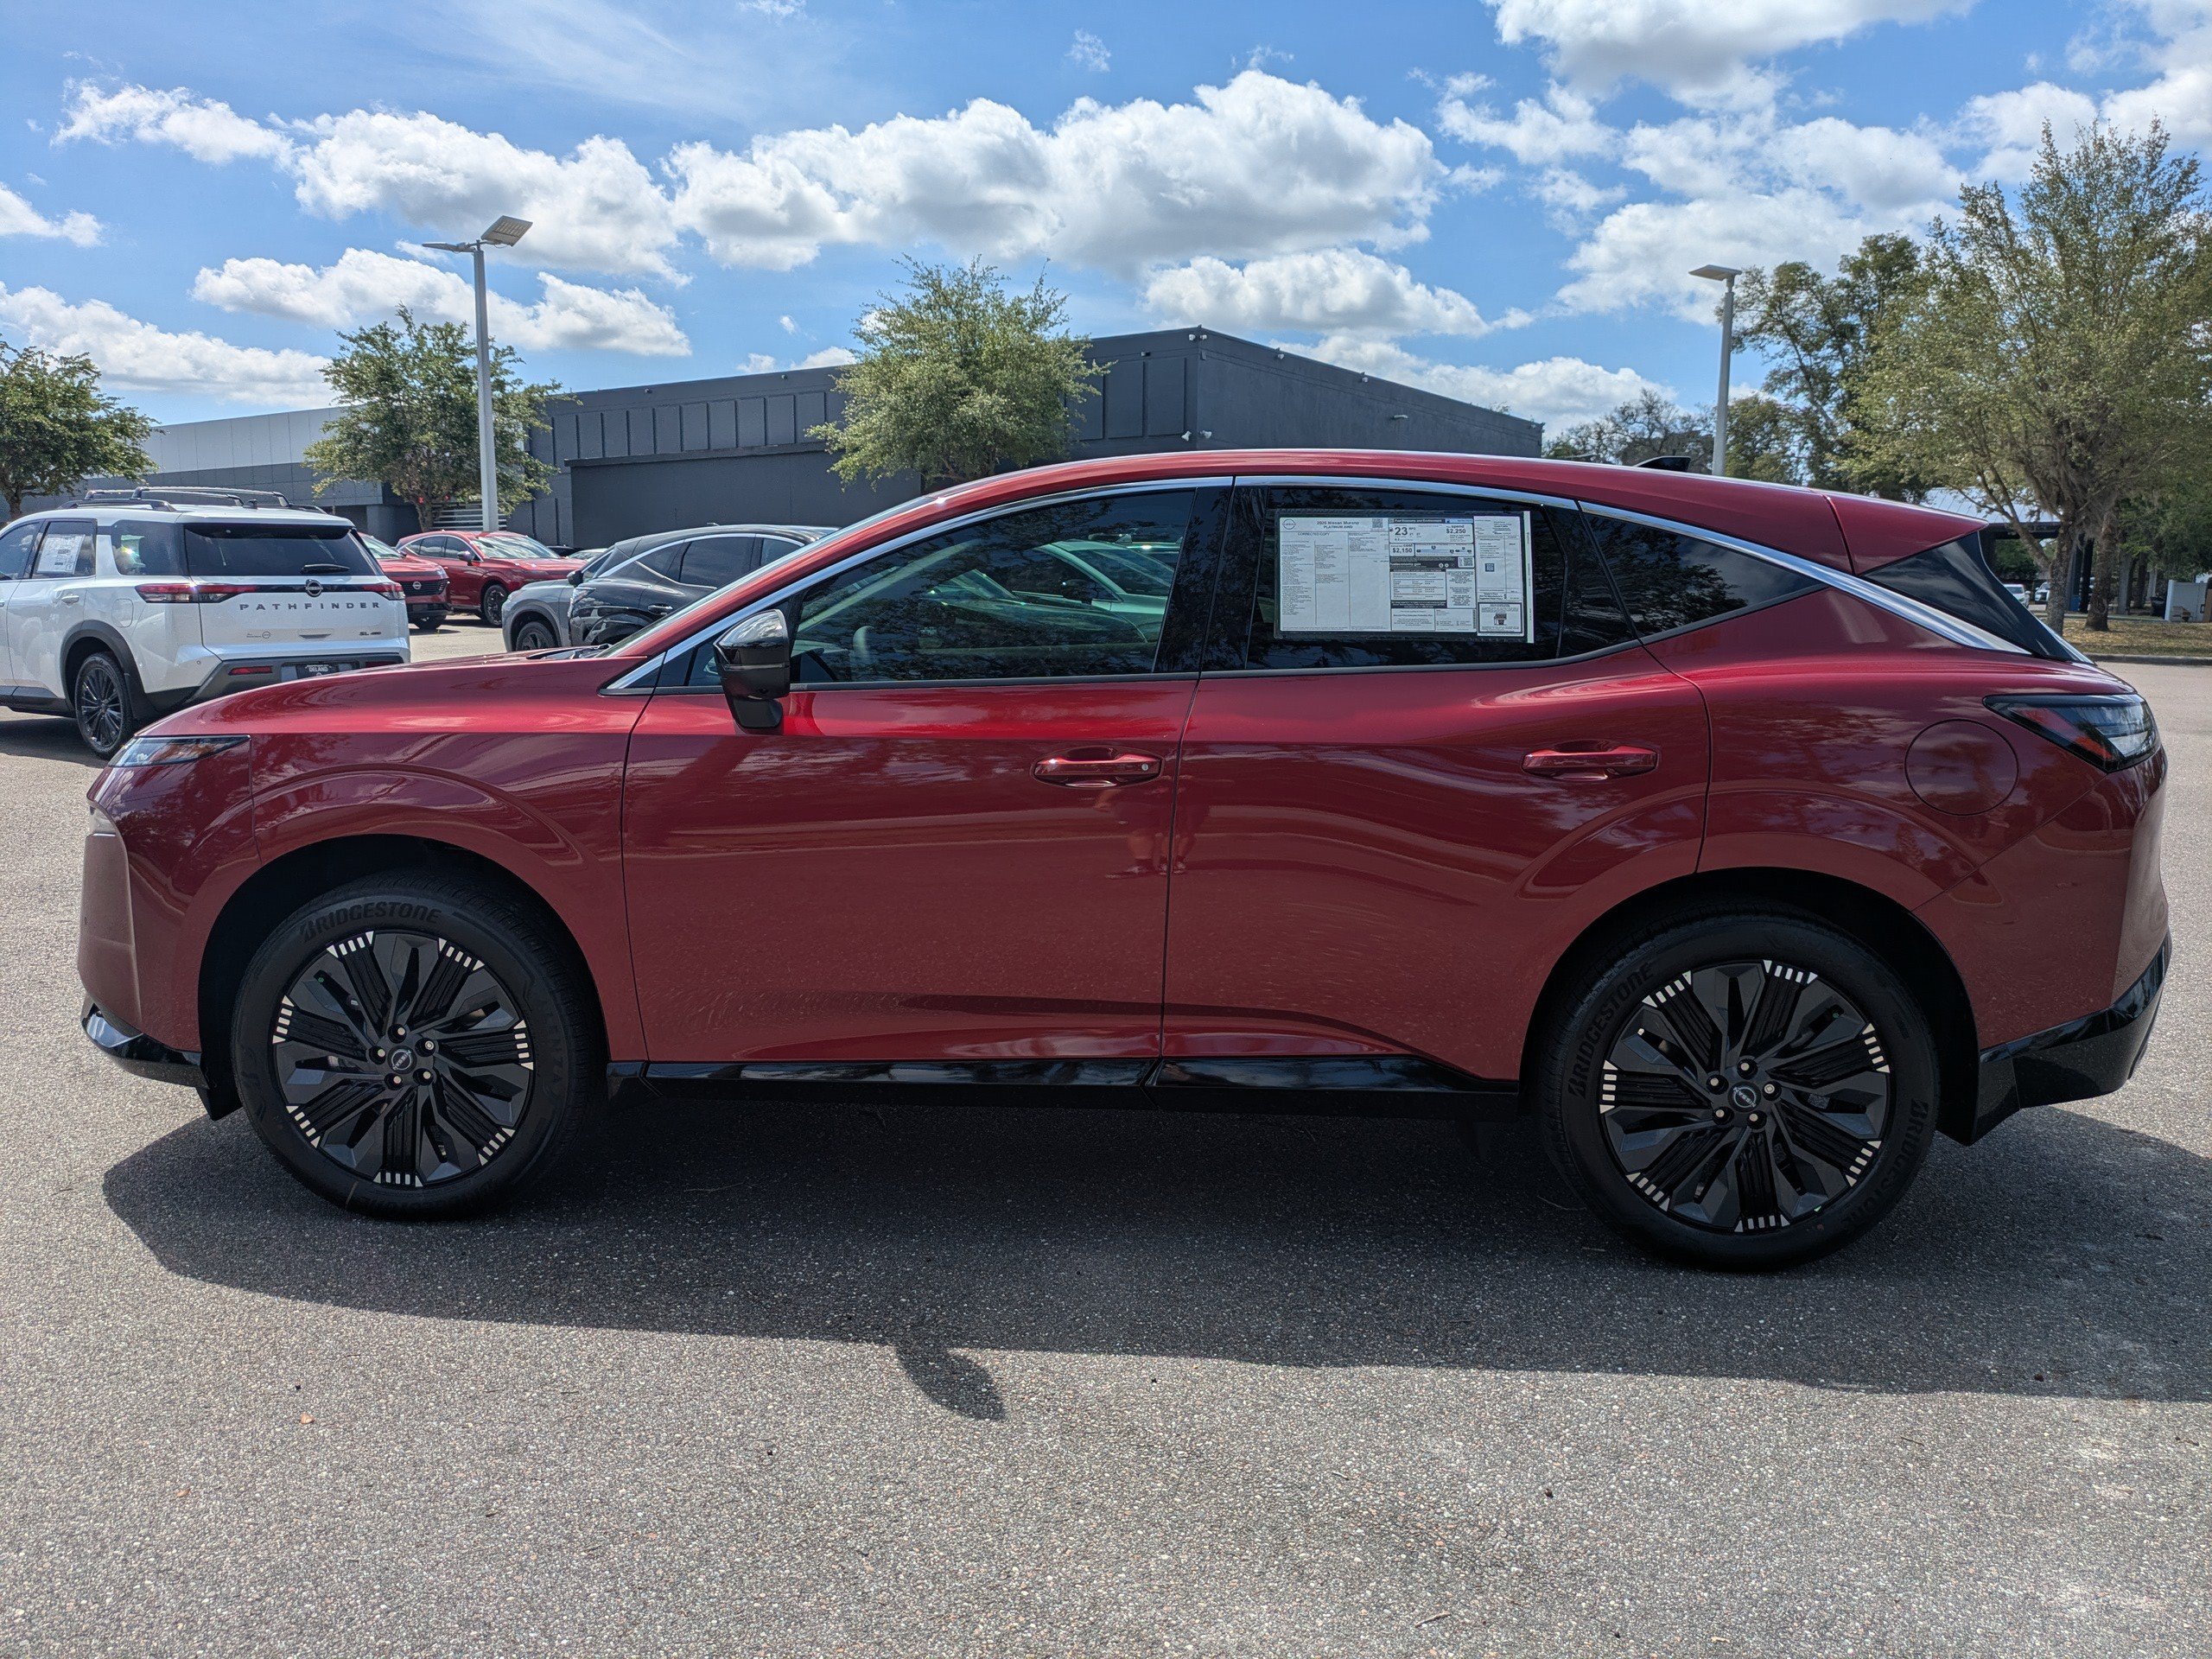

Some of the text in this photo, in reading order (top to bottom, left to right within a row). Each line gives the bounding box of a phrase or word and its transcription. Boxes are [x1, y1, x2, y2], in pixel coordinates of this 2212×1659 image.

[1395, 526, 1408, 536] 23
[239, 601, 380, 611] PATHFINDER
[300, 900, 442, 942] BRIDGESTONE
[1567, 961, 1655, 1100] BRIDGESTONE
